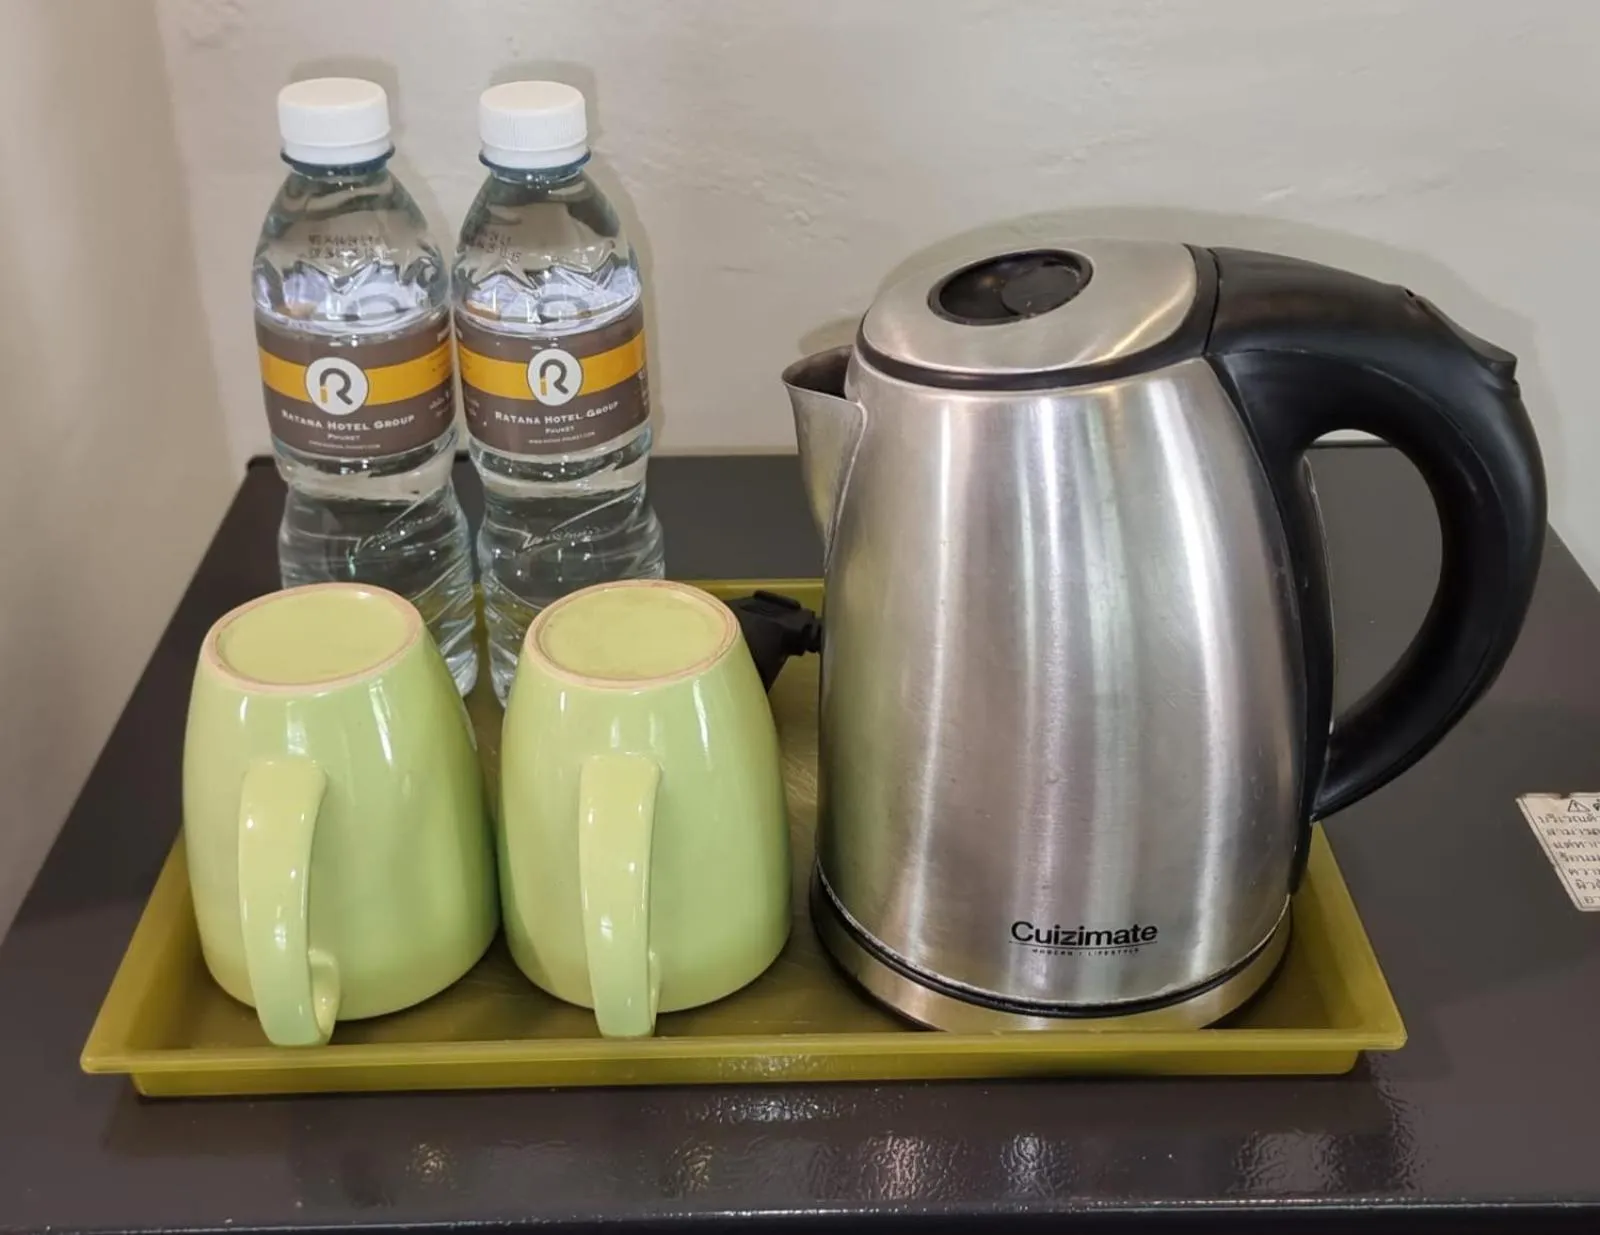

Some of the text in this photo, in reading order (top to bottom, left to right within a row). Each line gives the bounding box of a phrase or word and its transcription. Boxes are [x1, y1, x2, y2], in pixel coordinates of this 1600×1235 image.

[326, 420, 370, 431] HOTEL
[373, 414, 415, 430] GROUP
[494, 401, 619, 425] RATANA HOTEL GROUP
[1010, 920, 1158, 946] Cuizimate
